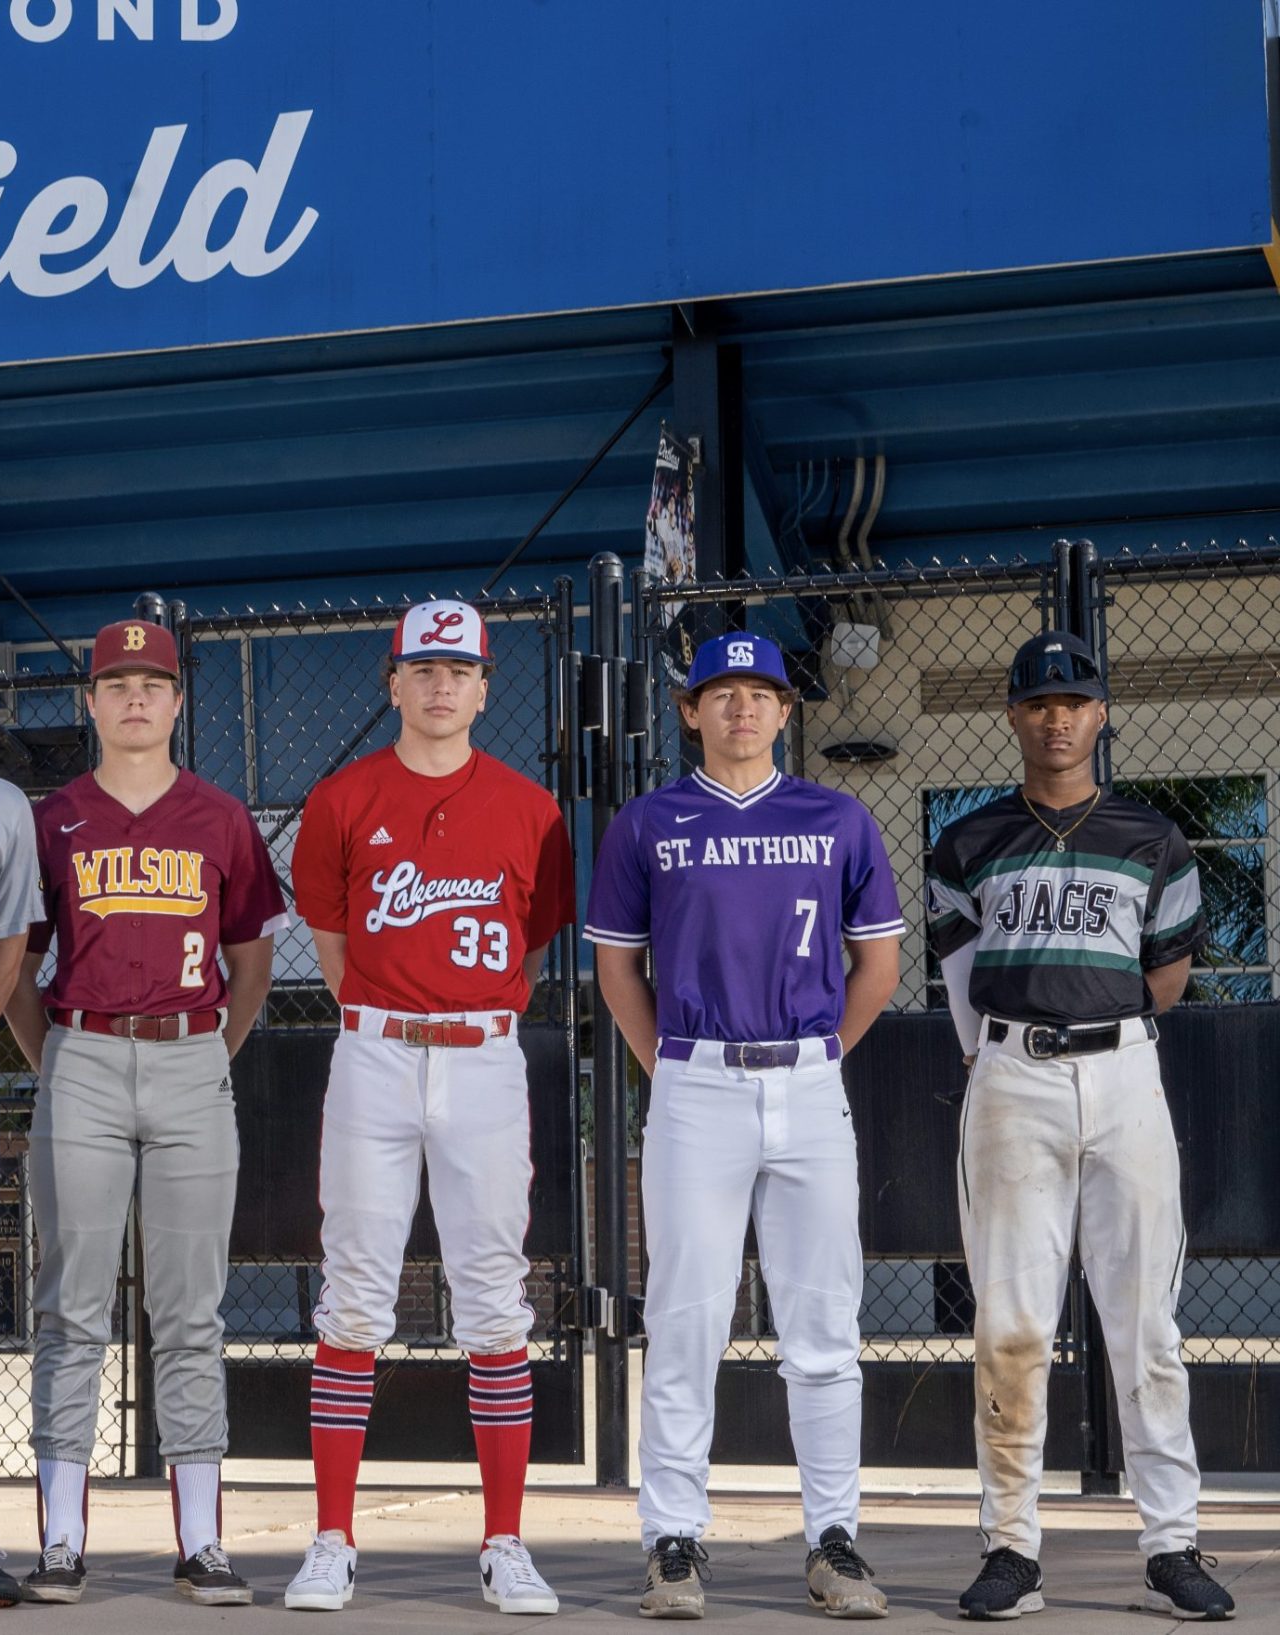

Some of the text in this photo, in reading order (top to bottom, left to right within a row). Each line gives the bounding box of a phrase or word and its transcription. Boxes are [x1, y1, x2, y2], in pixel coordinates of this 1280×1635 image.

[123, 625, 146, 651] B
[420, 610, 464, 645] L
[72, 847, 204, 898] WILSON
[655, 835, 835, 872] ST. ANTHONY
[366, 860, 505, 933] Lakewood
[995, 880, 1118, 938] JAGS
[450, 916, 509, 972] 33
[795, 899, 818, 957] 7
[180, 931, 205, 988] 2
